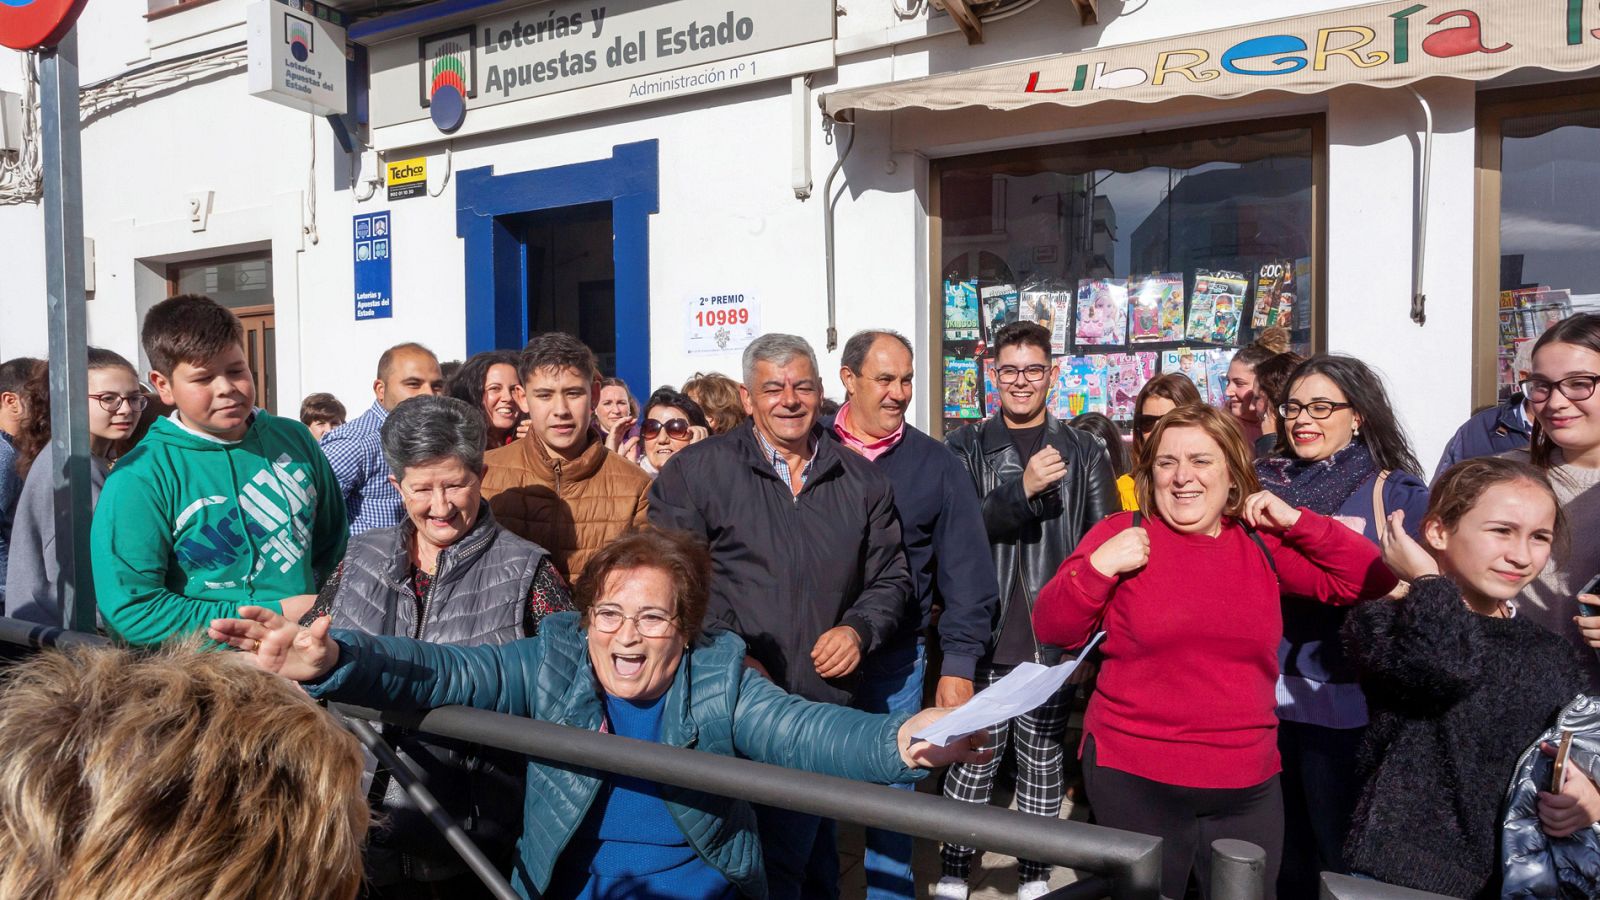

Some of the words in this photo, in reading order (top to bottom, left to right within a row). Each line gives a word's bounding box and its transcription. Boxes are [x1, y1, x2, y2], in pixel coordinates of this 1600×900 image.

[484, 9, 582, 54] Loterías
[591, 7, 606, 38] y
[485, 50, 597, 97] Apuestas
[606, 31, 646, 68] del
[657, 11, 754, 58] Estado
[286, 70, 320, 87] Apuestas
[322, 82, 334, 92] del
[286, 79, 311, 94] Estado
[629, 67, 725, 97] Administración
[750, 61, 757, 76] 1
[357, 300, 380, 309] Apuestas
[381, 298, 390, 306] del
[711, 294, 744, 305] PREMIO
[357, 308, 375, 317] Estado
[696, 308, 748, 327] 10989
[1168, 353, 1206, 363] buda
